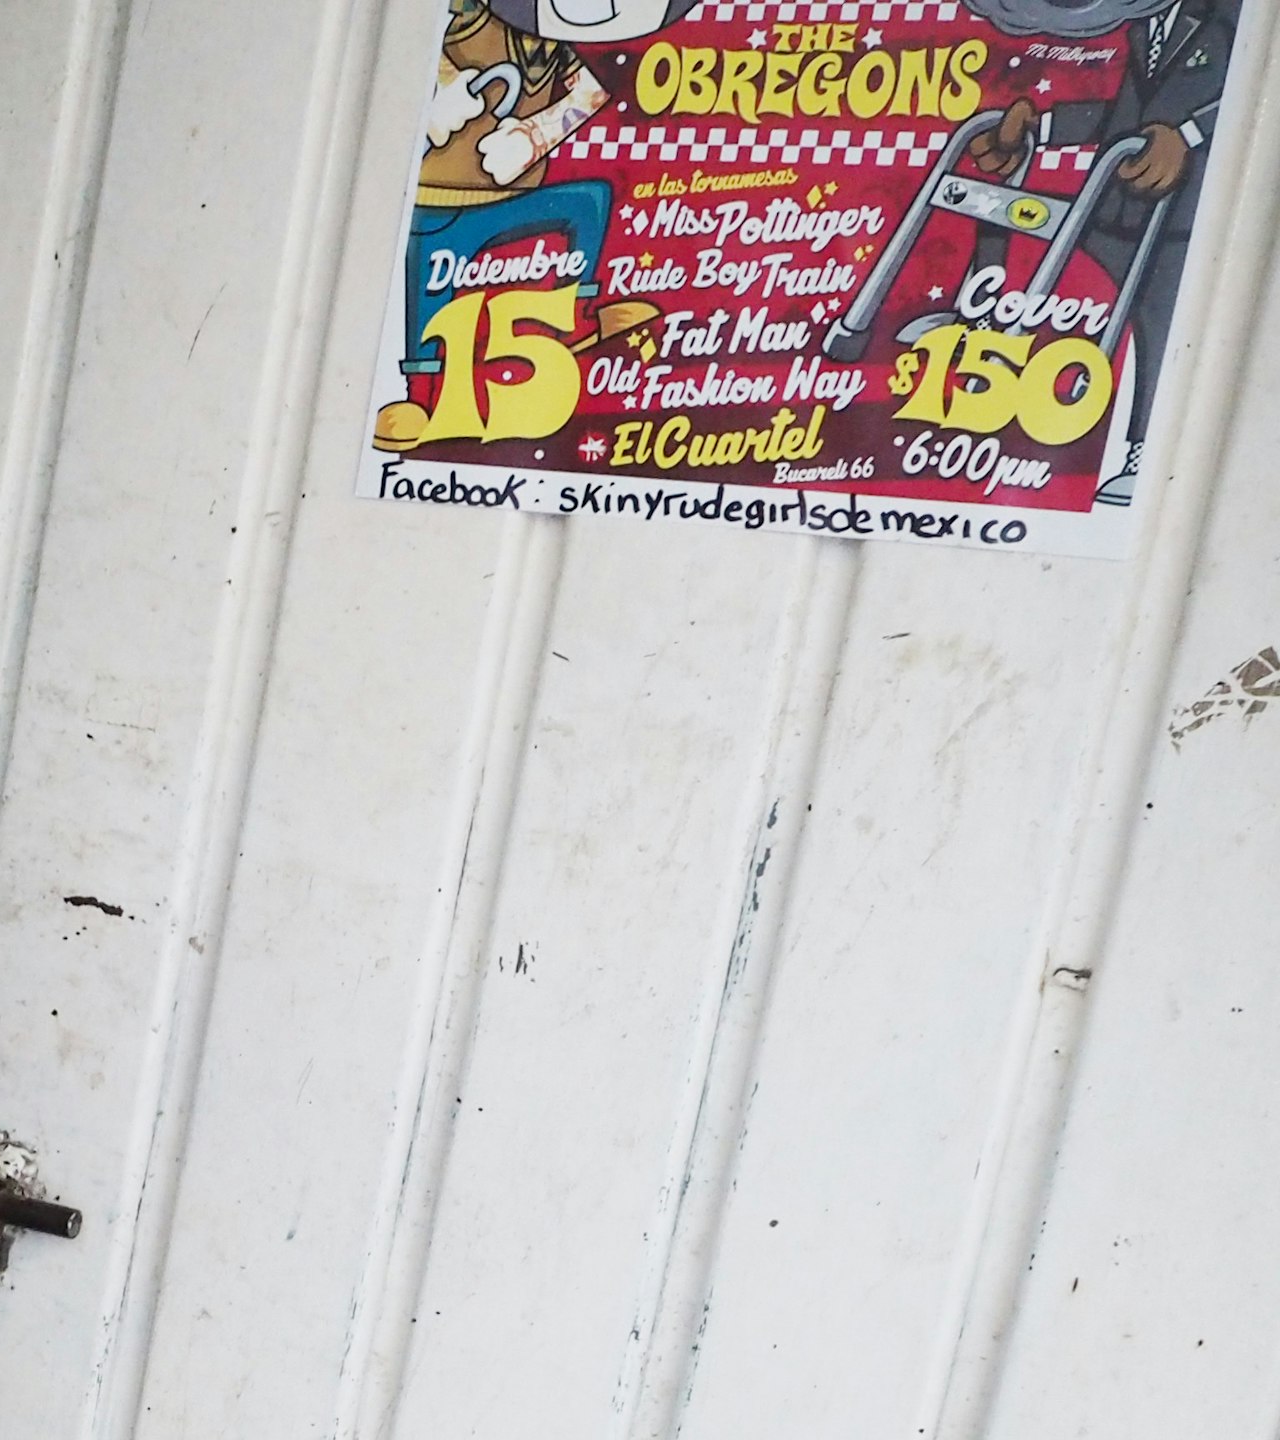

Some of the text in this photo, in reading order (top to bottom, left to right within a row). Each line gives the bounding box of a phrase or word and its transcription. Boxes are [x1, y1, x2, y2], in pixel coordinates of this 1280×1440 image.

[771, 22, 859, 52] THE
[635, 39, 988, 124] OBREGONS
[633, 168, 798, 199] en las tornamesas
[649, 197, 885, 252] Miss Pottinger
[426, 239, 588, 290] Diciembre
[607, 249, 856, 298] Rude Boy Train
[959, 265, 1109, 335] Cover
[659, 306, 811, 358] Fat Man
[417, 281, 581, 444] 15
[587, 355, 866, 411] Old Fashion Way
[888, 323, 1113, 445] $150
[609, 404, 826, 469] El Cuartel
[902, 430, 1051, 496] 6:00pm
[773, 457, 875, 484] Bucareli 66
